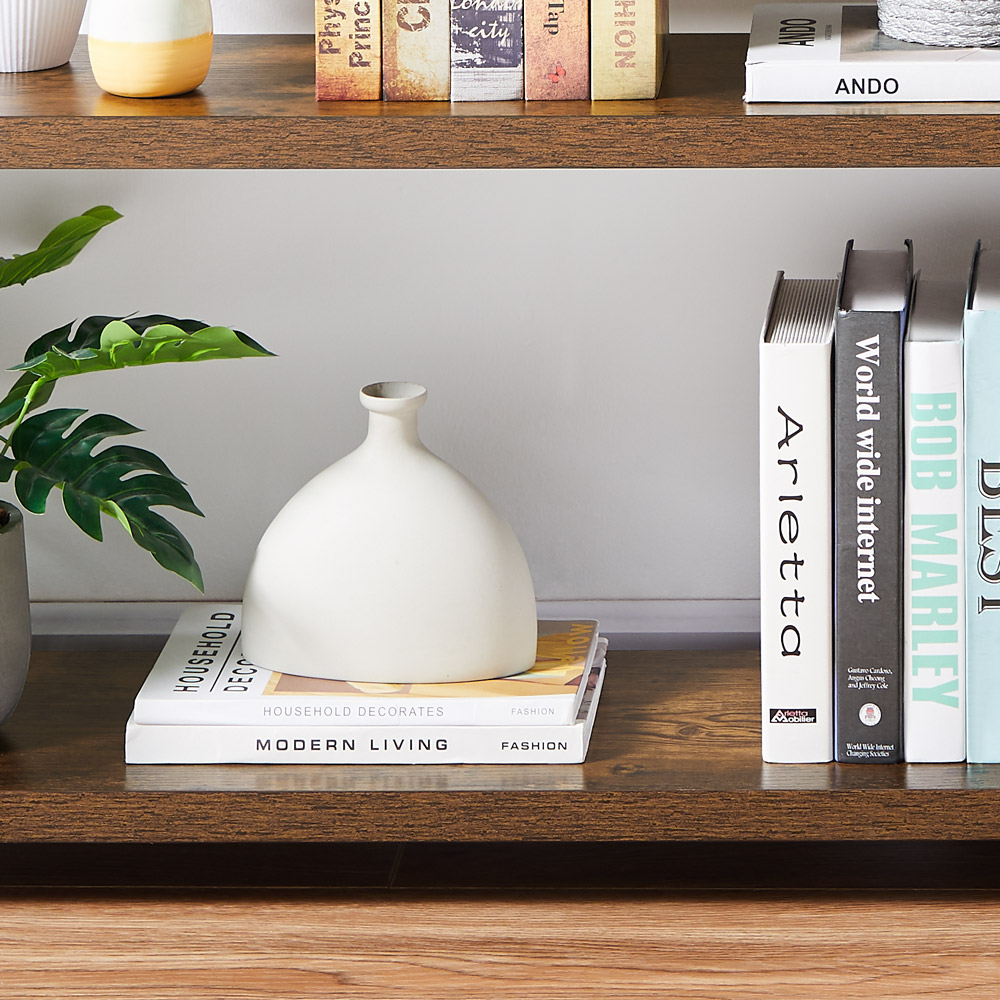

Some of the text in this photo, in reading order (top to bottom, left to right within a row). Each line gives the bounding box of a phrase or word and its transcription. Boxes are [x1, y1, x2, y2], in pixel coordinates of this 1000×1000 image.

[467, 20, 510, 44] city
[778, 18, 817, 47] ANDO
[834, 77, 900, 95] ANDO
[855, 333, 882, 604] World wide internet
[777, 405, 805, 657] Arletta
[910, 392, 959, 709] BOB MARLEY
[172, 612, 236, 693] HOUSEHOLD
[262, 706, 445, 718] HOUSEHOLD DECORATES
[510, 707, 556, 716] FASHION
[256, 738, 449, 752] MODERN LIVING
[500, 740, 569, 752] FASHION
